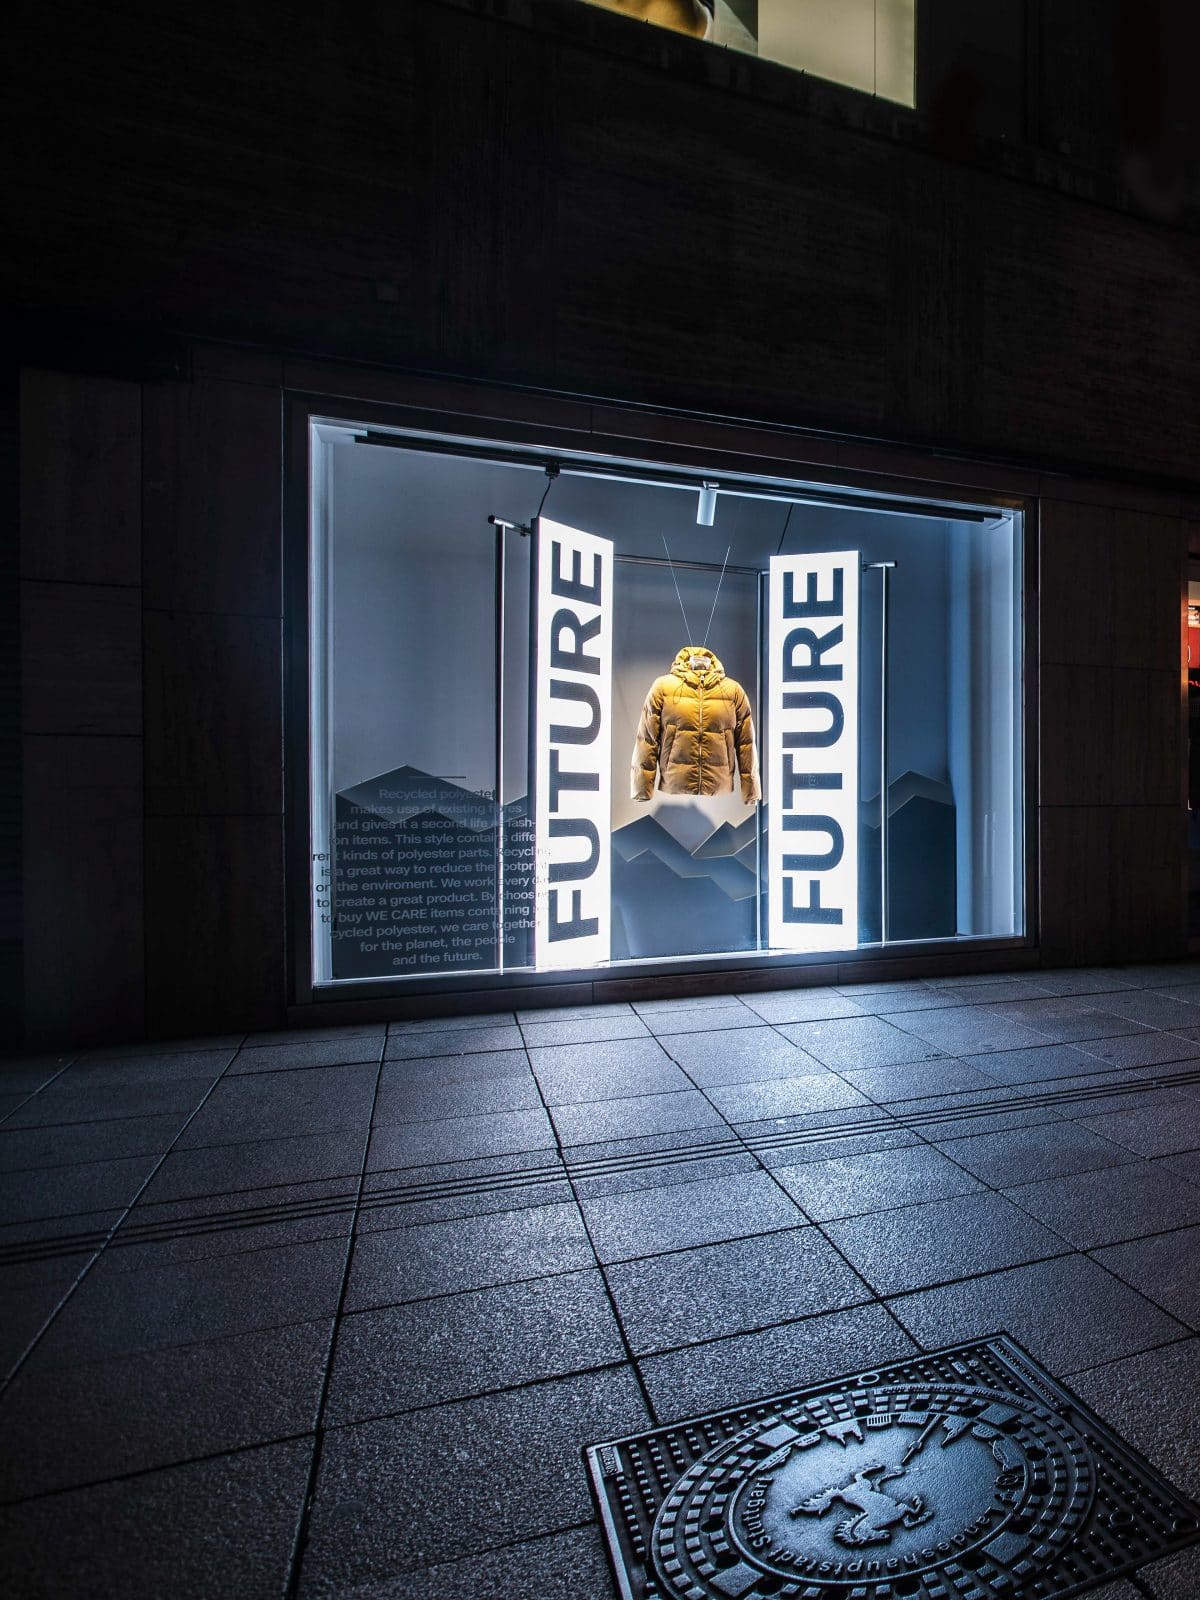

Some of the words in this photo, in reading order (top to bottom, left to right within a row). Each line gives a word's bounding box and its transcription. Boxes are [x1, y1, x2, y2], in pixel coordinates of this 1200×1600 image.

[547, 539, 602, 943] FUTURE
[781, 566, 845, 926] FUTURE
[379, 788, 437, 800] Recycled
[350, 804, 394, 815] makes
[397, 806, 419, 814] use
[422, 804, 436, 814] of
[439, 803, 486, 816] existing
[361, 820, 396, 832] gives
[400, 819, 408, 830] it
[410, 821, 419, 830] a
[421, 818, 469, 829] second
[470, 818, 488, 828] life
[352, 834, 392, 845] items.
[394, 834, 422, 844] This
[424, 833, 454, 846] style
[343, 850, 379, 860] kinds
[381, 849, 395, 860] of
[397, 848, 455, 862] polyester
[458, 847, 493, 860] parts.
[336, 868, 344, 876] a
[346, 866, 382, 878] great
[384, 866, 411, 876] way
[413, 864, 427, 874] to
[429, 862, 473, 873] reduce
[475, 862, 496, 872] the
[337, 881, 359, 891] the
[361, 879, 438, 890] enviroment.
[440, 878, 461, 888] We
[464, 876, 494, 887] work
[316, 898, 330, 908] to
[335, 896, 376, 907] create
[378, 898, 387, 906] a
[390, 894, 424, 907] great
[426, 892, 479, 906] product.
[480, 891, 496, 903] By
[338, 912, 363, 924] buy
[365, 910, 388, 921] WE
[391, 908, 428, 920] CARE
[430, 907, 465, 918] items
[376, 924, 437, 939] polyester,
[440, 924, 460, 933] we
[462, 922, 489, 932] care
[360, 941, 379, 953] for
[381, 939, 403, 951] the
[405, 938, 448, 952] planet,
[451, 936, 472, 947] the
[392, 953, 417, 966] and
[420, 952, 441, 963] the
[443, 950, 483, 962] future.
[741, 1476, 774, 1549] Stuttgart
[767, 1506, 1004, 1577] Landeshauptstadt
